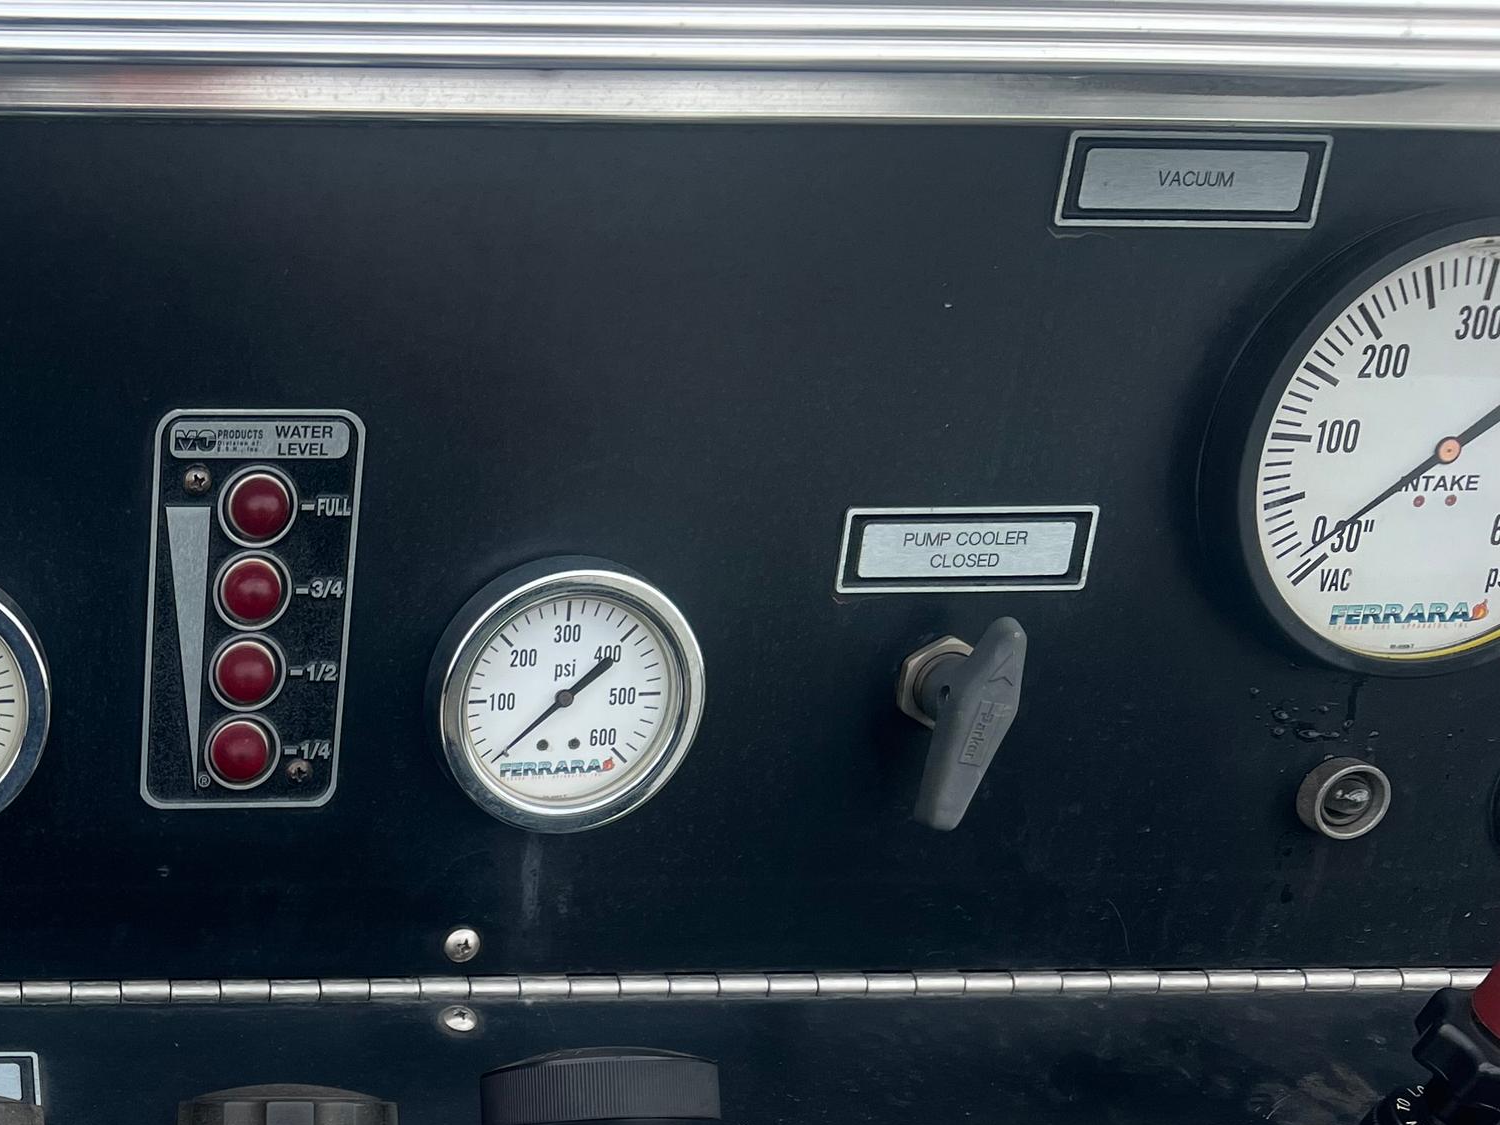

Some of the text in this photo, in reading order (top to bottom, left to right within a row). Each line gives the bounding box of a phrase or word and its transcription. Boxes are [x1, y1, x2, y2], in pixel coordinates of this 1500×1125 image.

[1158, 170, 1237, 188] VACUUM
[1455, 304, 1500, 340] 300
[1357, 344, 1410, 379] 200
[217, 429, 264, 440] PRODUCTS
[275, 425, 333, 439] WATER
[1316, 419, 1362, 454] 100
[277, 443, 329, 456] LEVEL
[1400, 475, 1480, 492] NTAKE
[317, 498, 351, 516] FULL
[902, 530, 1029, 547] PUMP COOLER
[930, 553, 1000, 569] CLOSED
[310, 580, 344, 598] 3/4
[1320, 568, 1353, 592] VAC
[1328, 601, 1473, 625] FERRARA
[553, 624, 581, 643] 300
[510, 648, 537, 667] 200
[306, 663, 338, 682] 1/2
[554, 659, 576, 682] psi
[489, 692, 515, 711] 100
[609, 687, 636, 705] 500
[589, 728, 617, 746] 600
[300, 742, 331, 760] 1/4
[500, 758, 602, 777] FERRARA
[1396, 1097, 1411, 1112] TO
